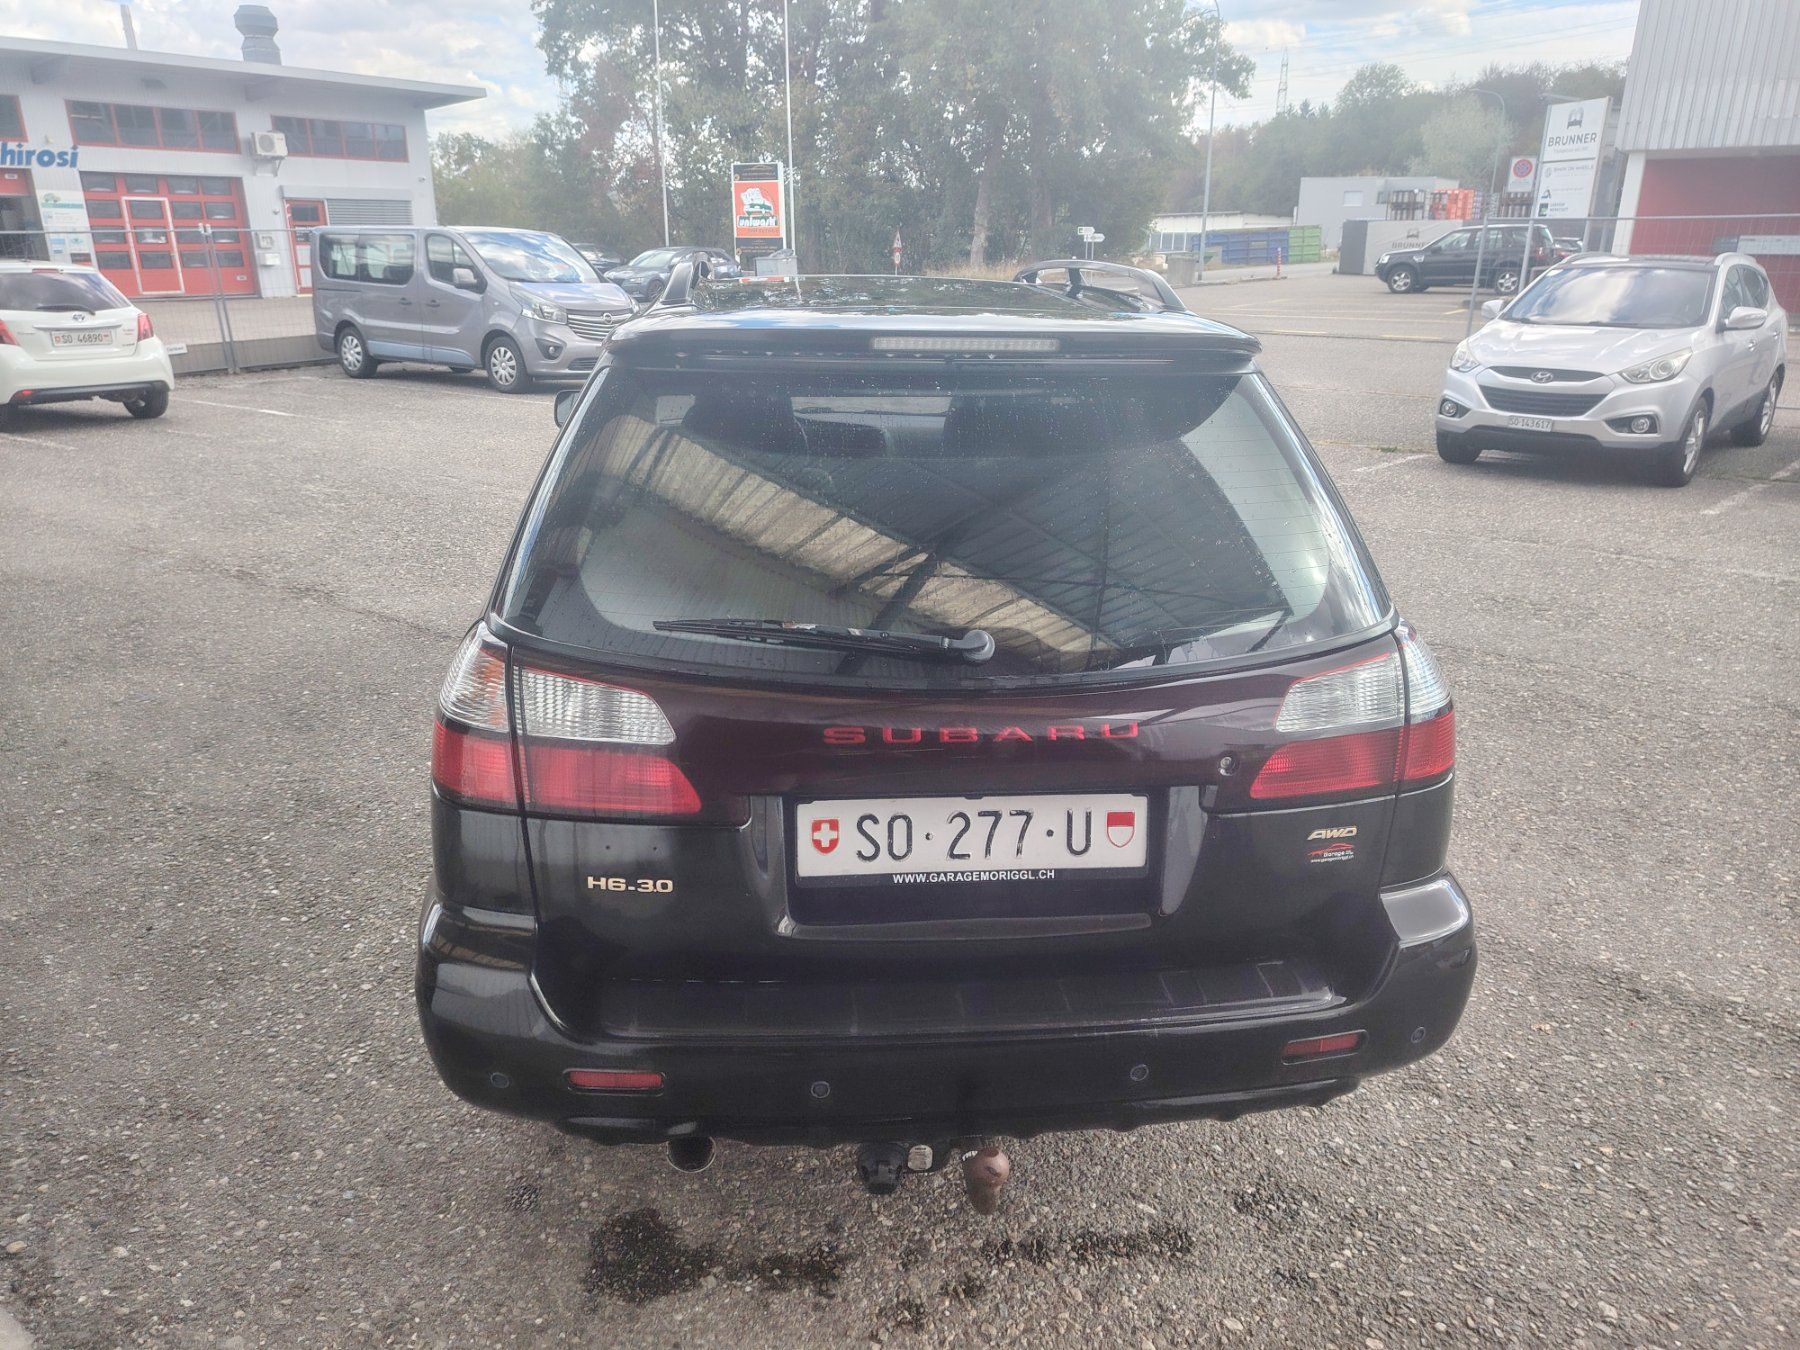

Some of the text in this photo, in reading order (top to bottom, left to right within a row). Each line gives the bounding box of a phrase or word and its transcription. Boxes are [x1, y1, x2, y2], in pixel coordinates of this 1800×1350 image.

[1548, 132, 1597, 147] BRUNNER
[0, 143, 79, 168] hirosi
[78, 333, 103, 343] 46890
[823, 721, 1139, 744] SUBARU
[1307, 826, 1357, 840] AWD
[893, 869, 1055, 884] WWW.GARAGEMORIGGL.CH
